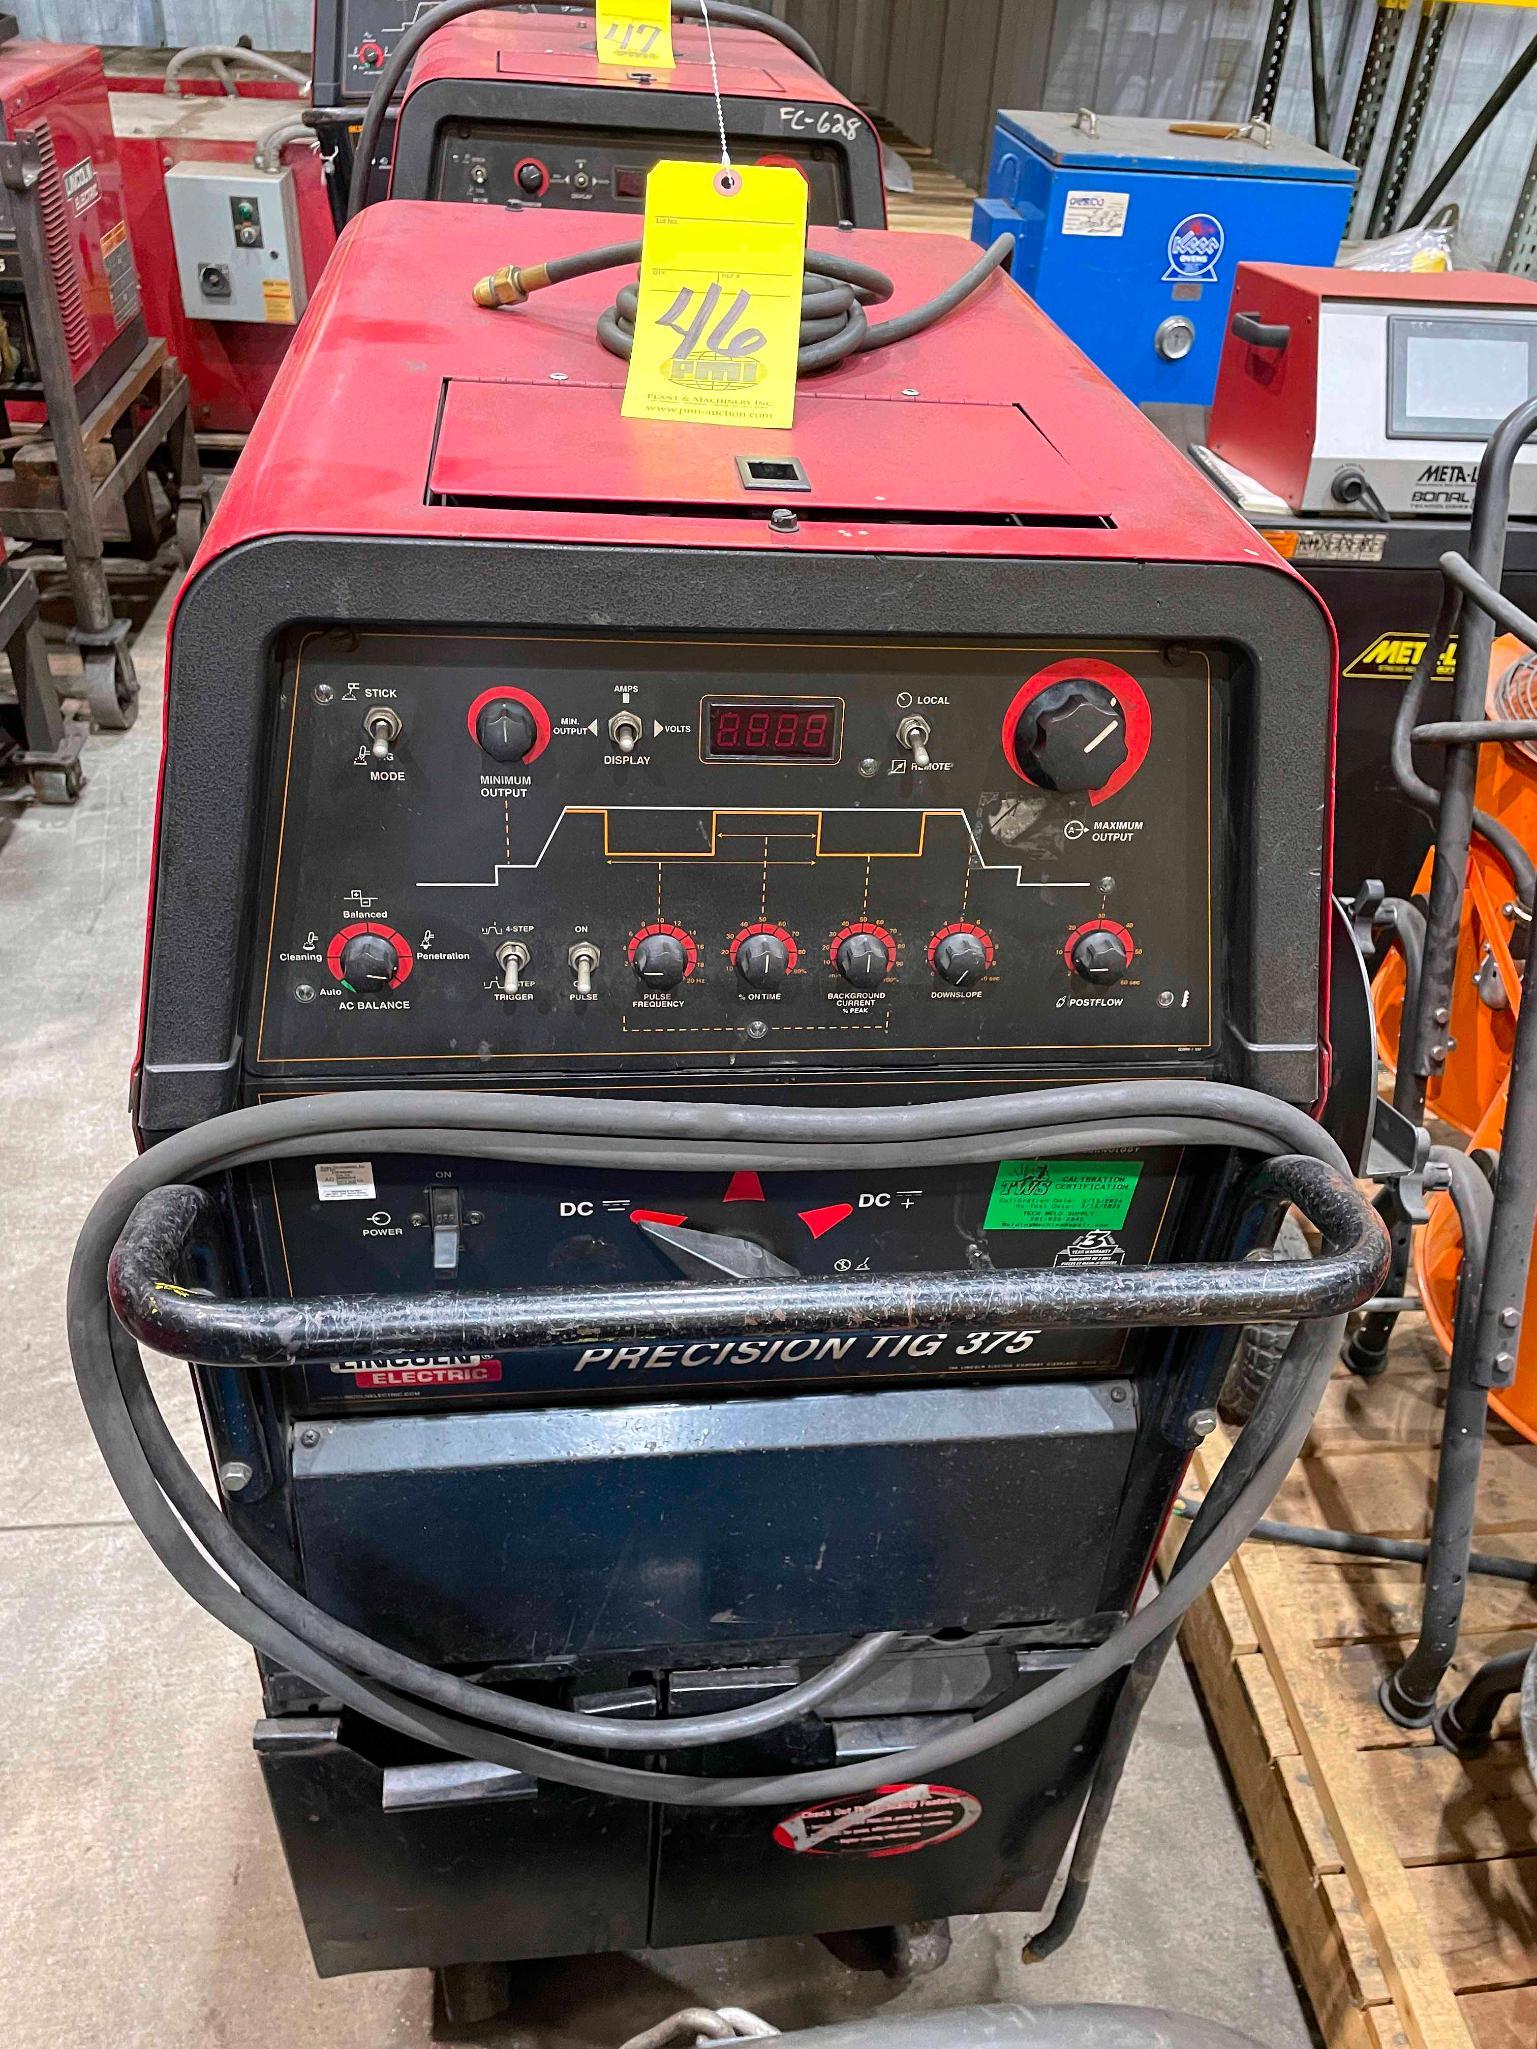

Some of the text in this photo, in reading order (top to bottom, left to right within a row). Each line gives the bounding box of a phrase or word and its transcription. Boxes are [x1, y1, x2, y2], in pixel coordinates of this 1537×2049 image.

[604, 23, 663, 52] 47
[779, 107, 862, 140] FC-628
[655, 283, 767, 359] 46
[365, 688, 397, 698] STICK
[614, 685, 639, 693] AMPS
[917, 696, 950, 705] LOCAL
[561, 717, 580, 725] MIN.
[553, 727, 588, 736] OUTPUT
[665, 725, 691, 733] VOLTS
[604, 755, 651, 765] DISPLAY
[370, 771, 405, 781] MODE
[480, 775, 532, 785] MINIMUM
[481, 788, 527, 798] OUTPUT
[1093, 821, 1144, 830] MAXIMUM
[1092, 832, 1134, 842] OUTPUT
[343, 910, 388, 919] Balanced
[505, 925, 535, 933] 4-STEP
[575, 925, 588, 933] ON
[279, 953, 323, 962] Cleaning
[416, 952, 470, 961] Penetration
[320, 988, 342, 996] Auto
[827, 992, 886, 1000] BACKGROUND
[931, 991, 983, 999] DOWNSLOPE
[493, 993, 534, 1001] TRIGGER
[569, 993, 598, 1001] PULSE
[339, 1001, 410, 1010] AC BALANCE
[1069, 998, 1124, 1007] POSTFLOW
[1001, 1180, 1053, 1196] TWS
[858, 1192, 891, 1208] DC
[560, 1201, 594, 1217] DC
[362, 1228, 403, 1237] POWER
[573, 1329, 1042, 1372] PRECISION TIG 375
[373, 1368, 488, 1384] ELECTRIC
[801, 1810, 831, 1819] Check
